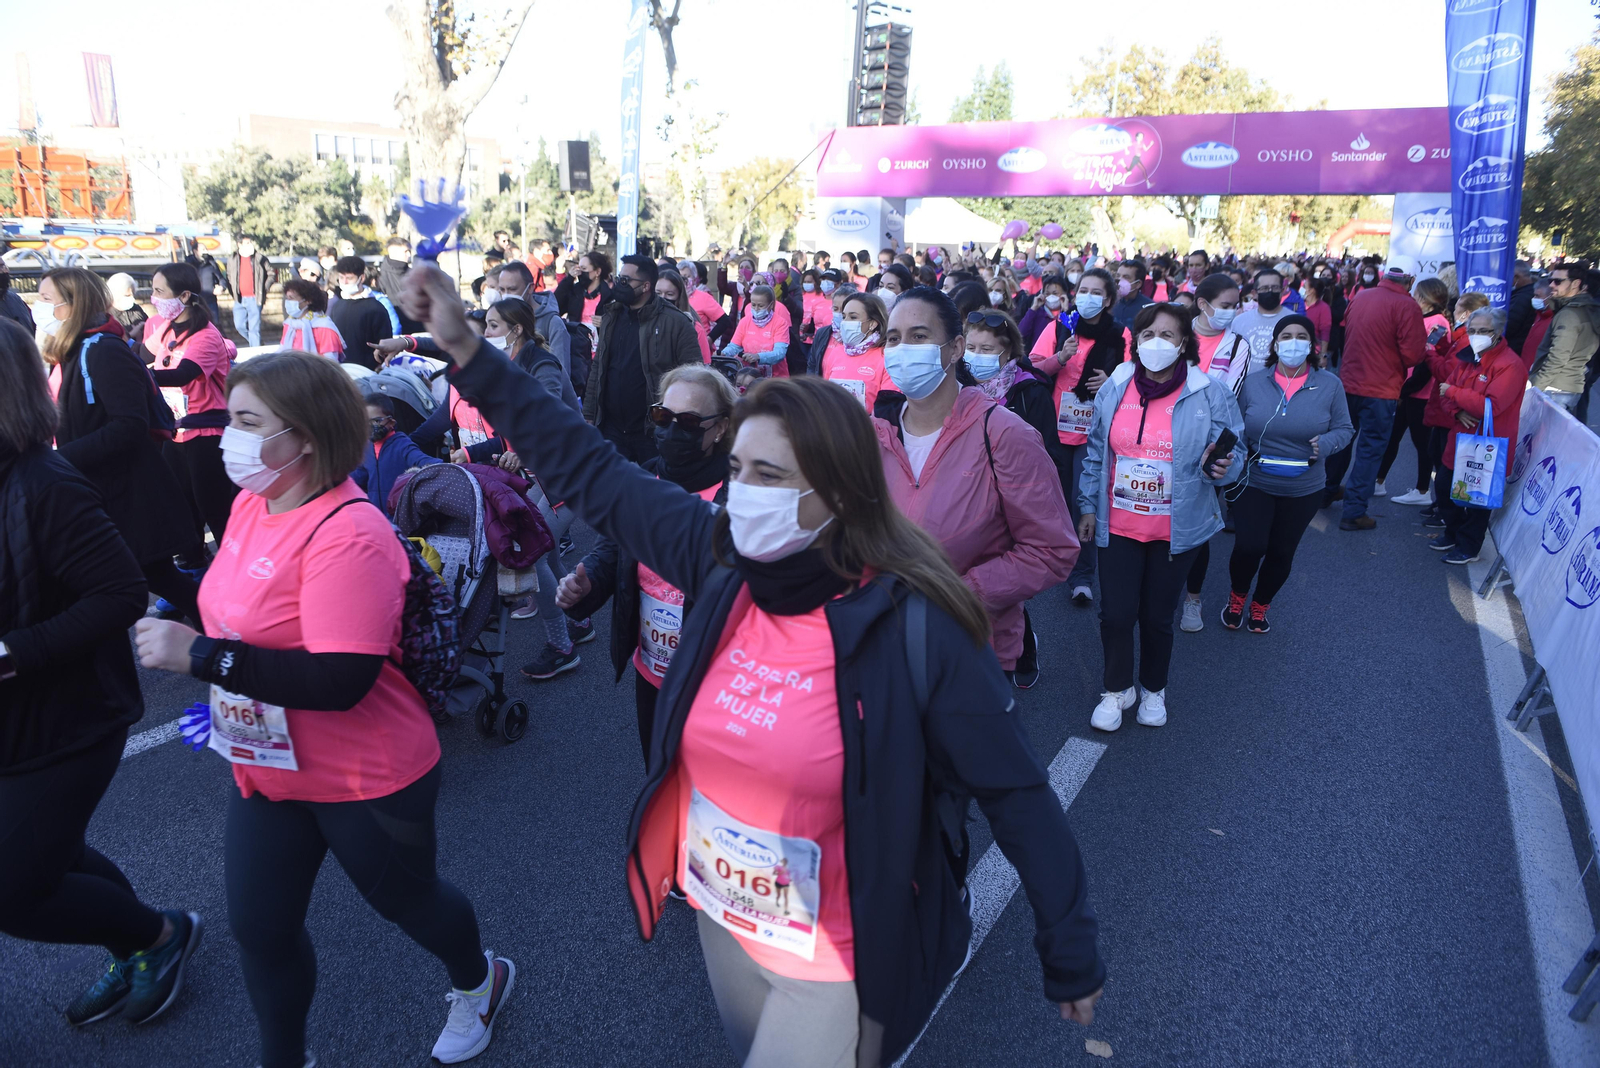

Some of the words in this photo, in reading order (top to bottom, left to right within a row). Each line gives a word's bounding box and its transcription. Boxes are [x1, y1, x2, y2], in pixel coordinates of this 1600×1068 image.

[942, 158, 987, 170] OYSHO
[1186, 152, 1235, 162] ASTURIANA
[1257, 149, 1313, 162] OYSHO
[1331, 151, 1387, 162] Santander
[894, 160, 929, 170] ZURICH
[1090, 165, 1132, 192] Mujer
[832, 217, 867, 226] ASTURIANA
[1073, 408, 1092, 418] 016
[1145, 449, 1172, 459] TODA
[1131, 479, 1157, 492] 016
[652, 612, 679, 629] ASTURIANA
[651, 629, 679, 651] 016
[730, 673, 757, 697] DE
[759, 685, 784, 708] LA
[220, 701, 254, 726] 016
[714, 689, 778, 732] MUJER
[725, 721, 747, 738] 2021
[715, 831, 773, 865] ASTURIANA
[715, 857, 772, 897] 016
[726, 887, 755, 908] 1548
